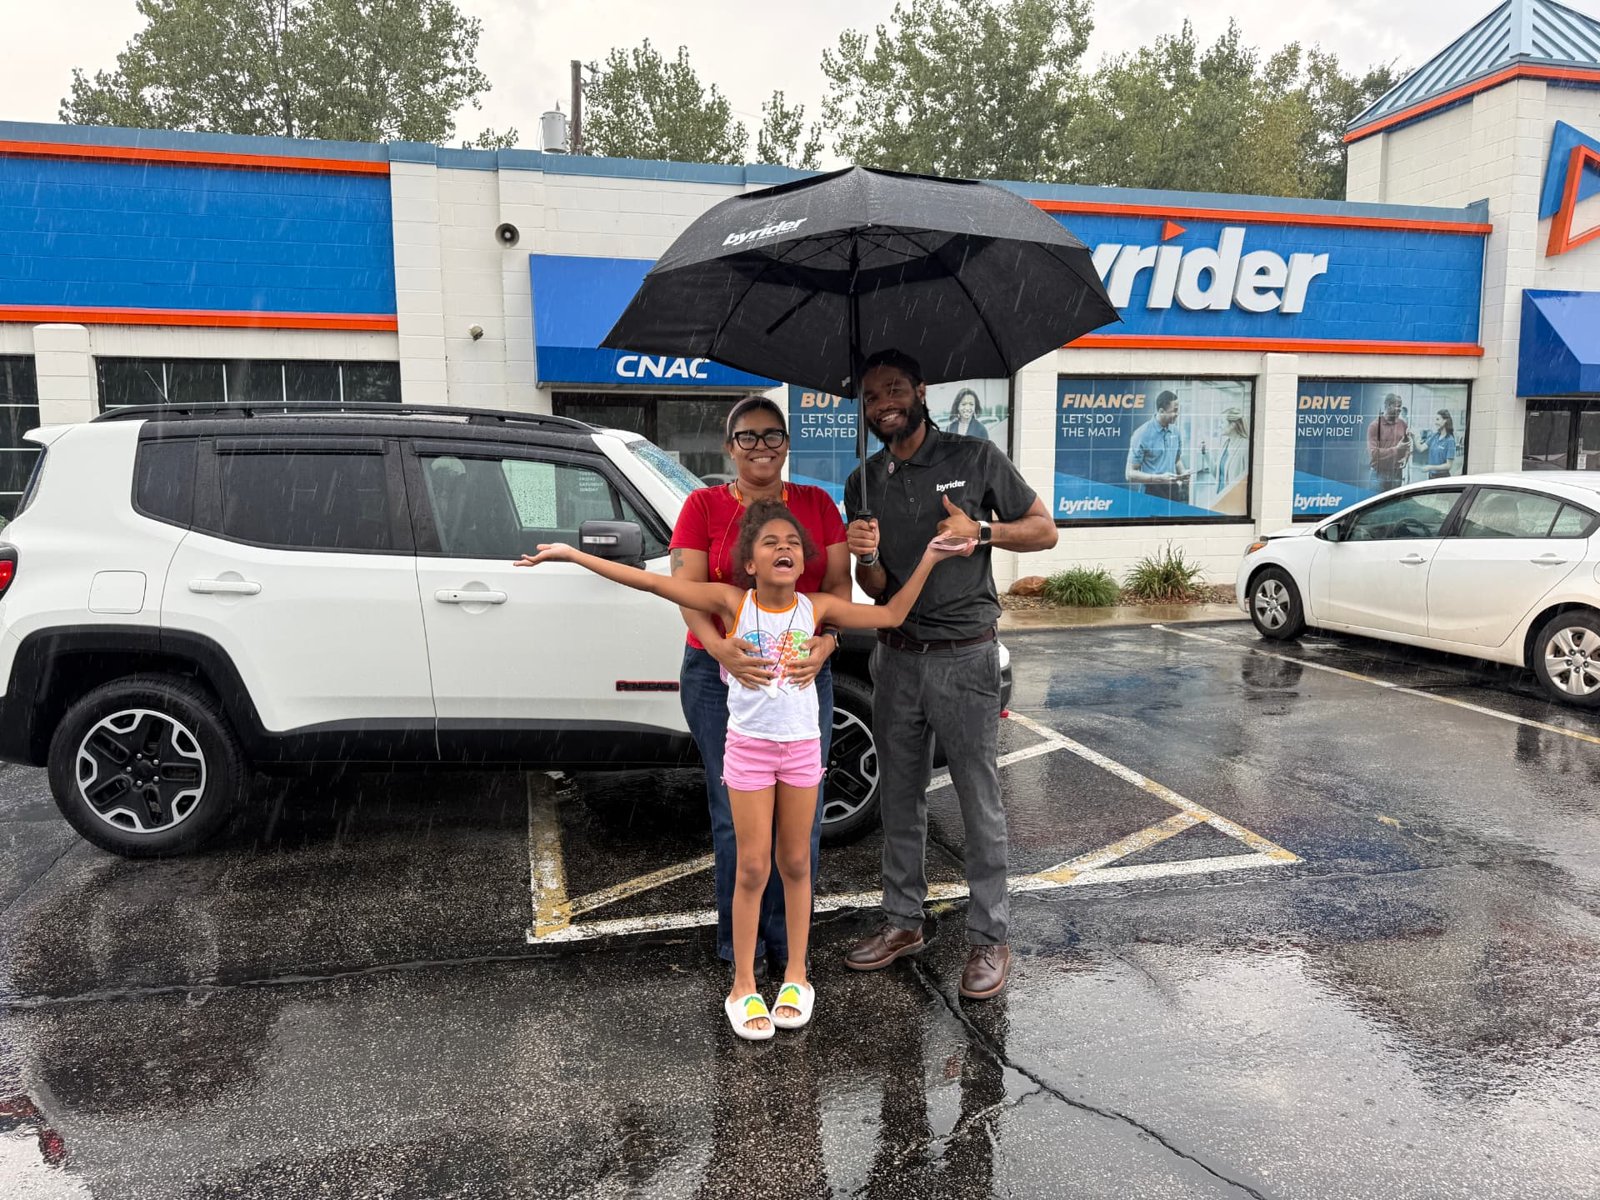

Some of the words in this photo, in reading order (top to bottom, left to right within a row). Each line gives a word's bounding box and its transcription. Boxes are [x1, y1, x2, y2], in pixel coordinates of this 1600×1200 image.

[721, 217, 808, 246] byrider
[1091, 220, 1329, 314] rider
[616, 355, 711, 379] CNAC
[800, 392, 842, 408] BUY
[1062, 393, 1146, 409] FINANCE
[1298, 395, 1351, 410] DRIVE
[801, 413, 835, 424] LET'S
[1062, 413, 1093, 425] LET'S
[1095, 414, 1114, 425] DO
[1298, 414, 1333, 425] ENJOY
[1334, 414, 1364, 425] YOUR
[801, 427, 858, 438] STARTED
[1062, 427, 1086, 437] THE
[1088, 427, 1121, 438] MATH
[1298, 427, 1323, 437] NEW
[1326, 427, 1353, 437] RIDE!
[936, 479, 967, 492] byrider
[1058, 495, 1113, 515] byrider
[1294, 493, 1343, 510] byrider
